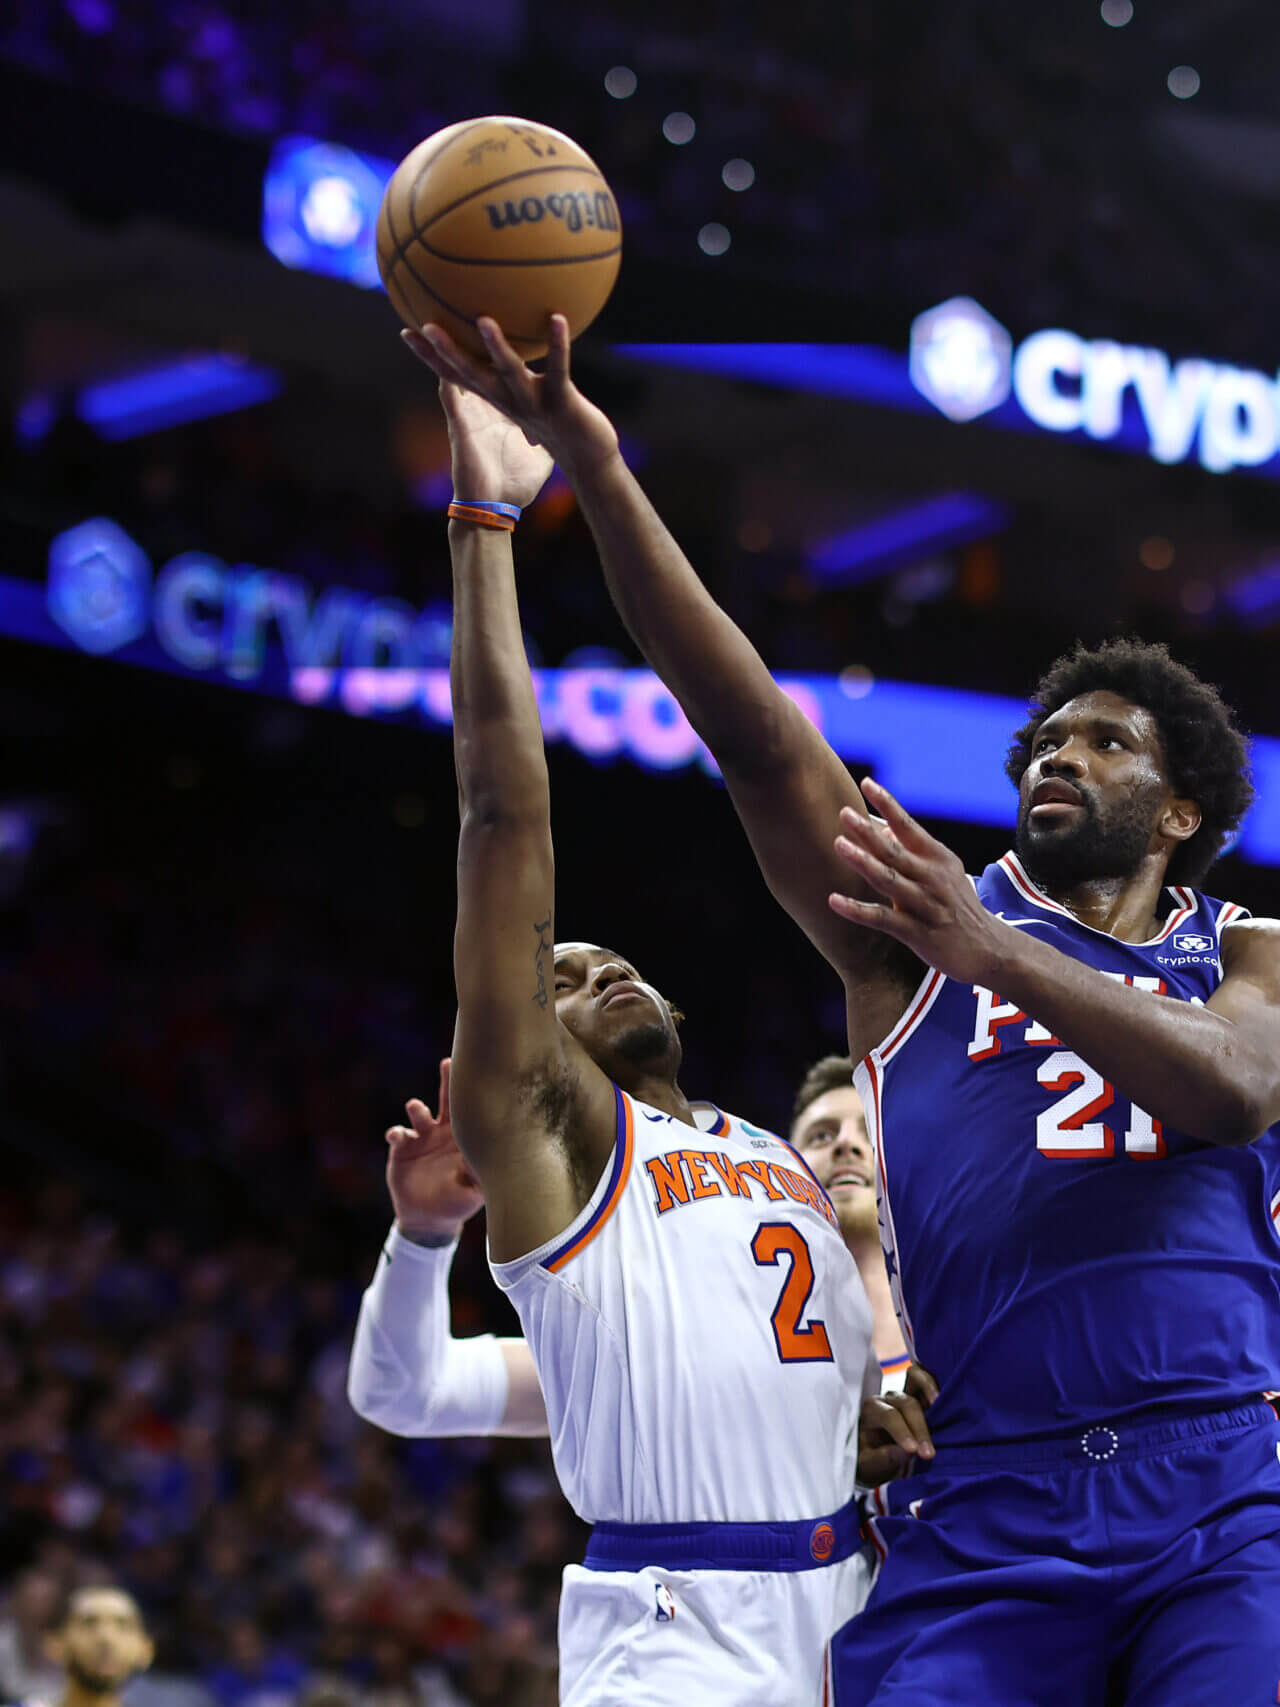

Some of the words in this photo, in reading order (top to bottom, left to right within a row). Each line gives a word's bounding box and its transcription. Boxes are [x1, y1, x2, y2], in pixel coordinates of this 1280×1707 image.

[484, 190, 620, 233] Wilson
[1156, 955, 1218, 967] crypto.co
[644, 1150, 752, 1218] NEW
[750, 1222, 835, 1364] 2
